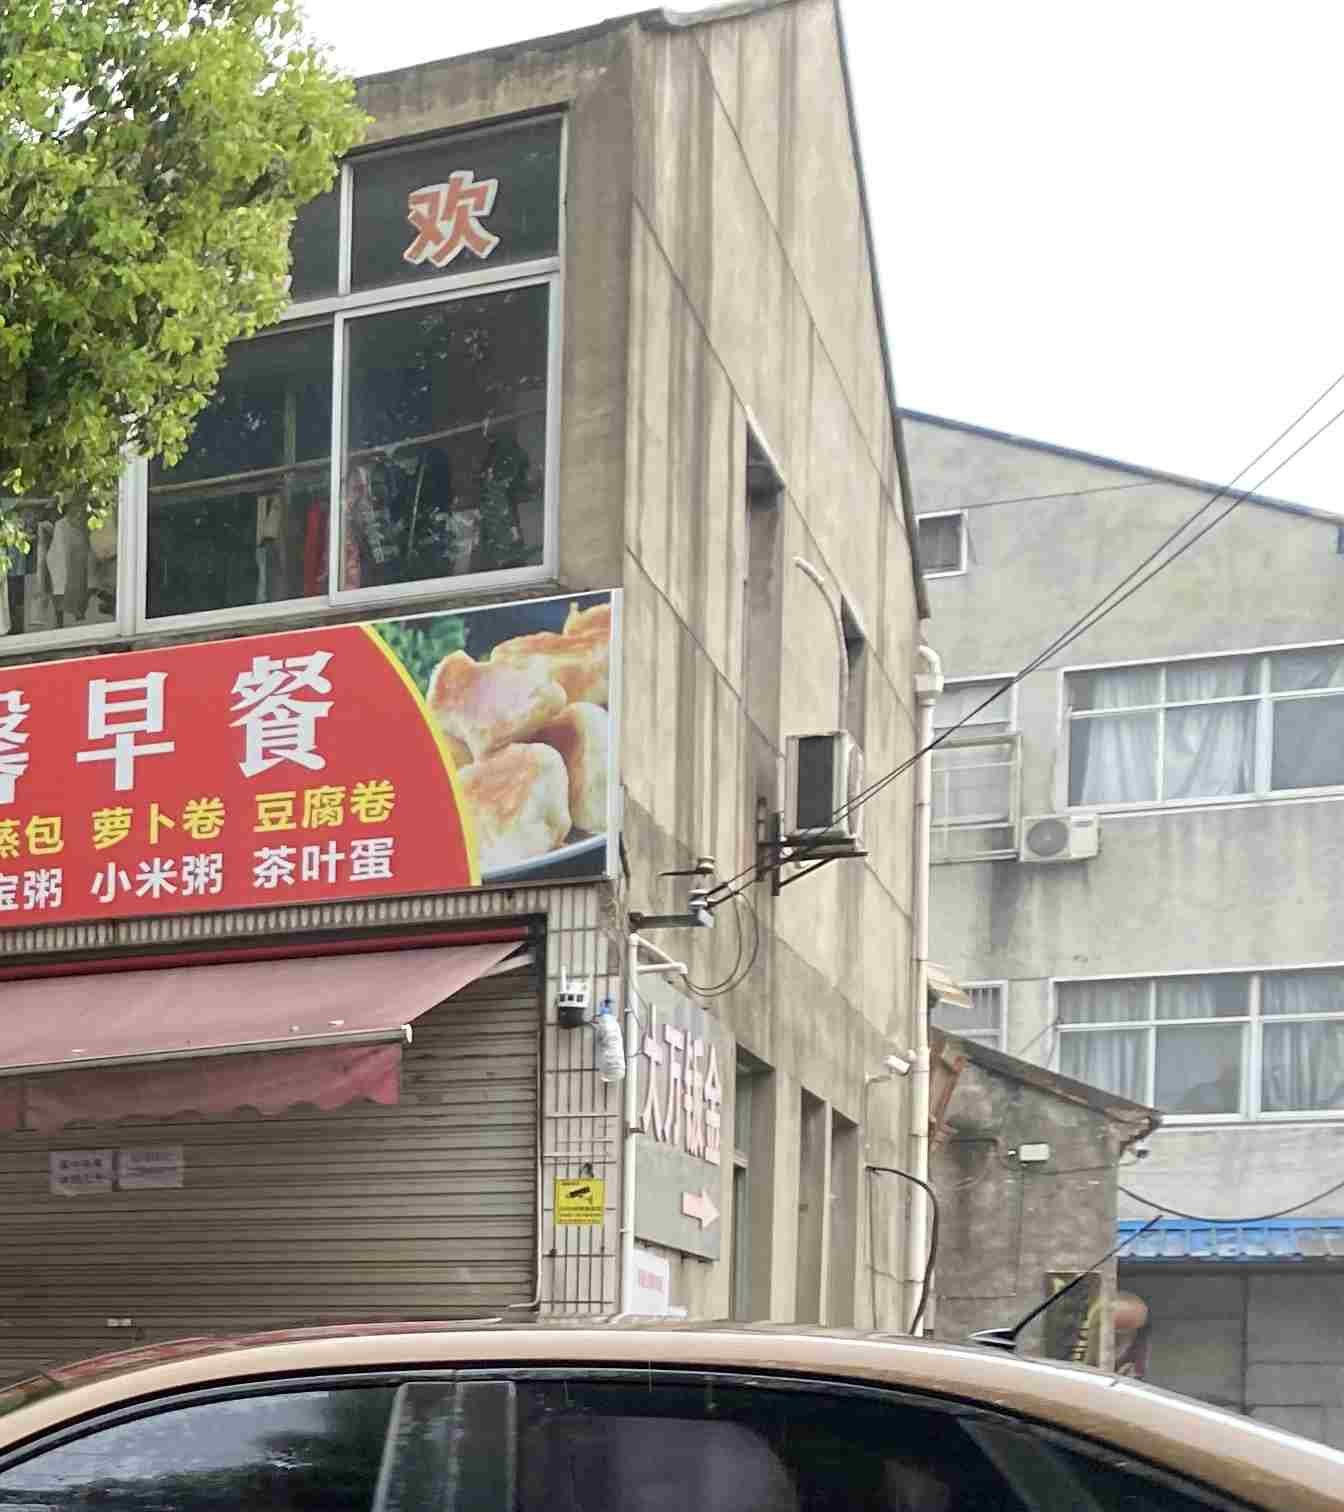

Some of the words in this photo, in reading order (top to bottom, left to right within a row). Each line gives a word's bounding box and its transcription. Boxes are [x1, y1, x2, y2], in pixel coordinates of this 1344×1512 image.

[403, 170, 500, 268] 欢
[91, 797, 226, 850] 萝卜卷
[253, 779, 396, 833] 豆腐卷
[90, 853, 224, 903] 小米粥
[253, 837, 394, 889] 茶叶蛋
